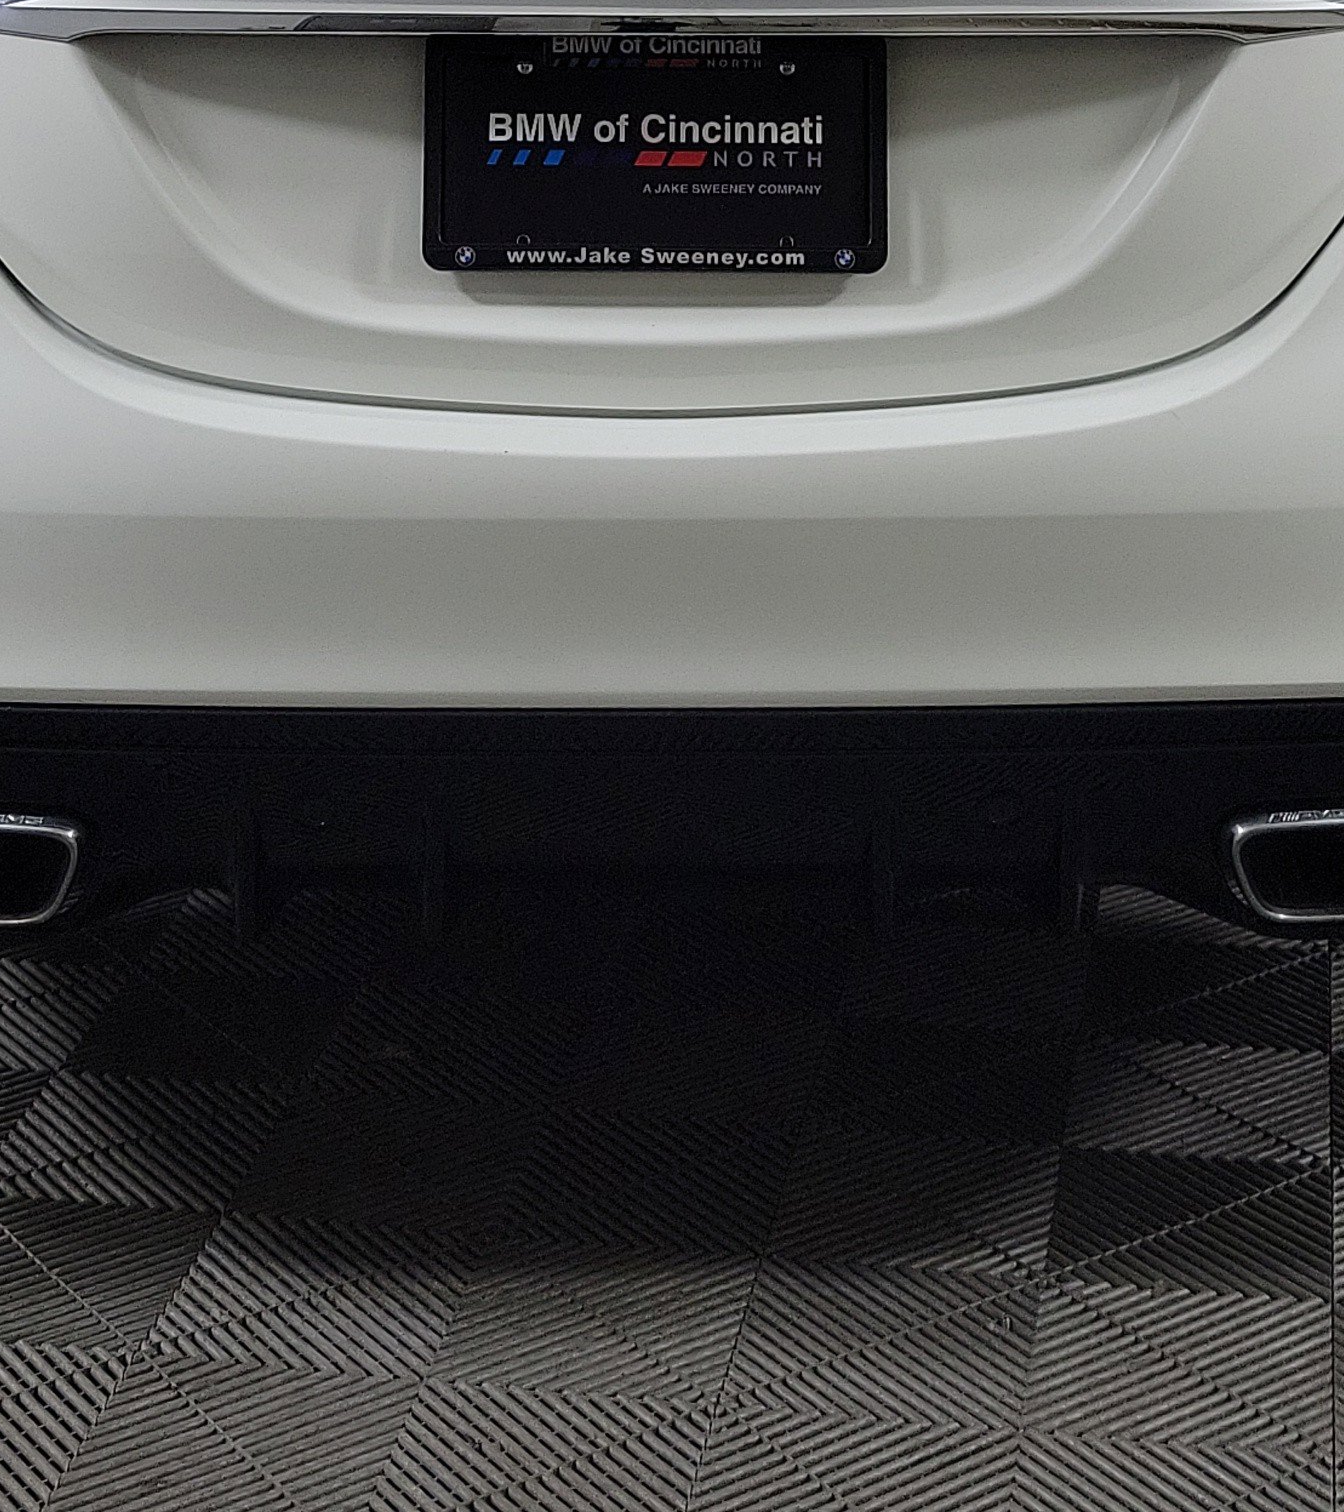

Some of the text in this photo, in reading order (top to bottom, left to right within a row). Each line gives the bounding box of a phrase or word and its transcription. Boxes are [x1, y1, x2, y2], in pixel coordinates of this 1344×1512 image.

[488, 112, 824, 145] BMW of Cincinnati
[713, 150, 822, 168] NORTH
[642, 183, 823, 195] A JAKE SWEENEY COMPANY
[506, 247, 806, 269] www.Jake Sweeney.com
